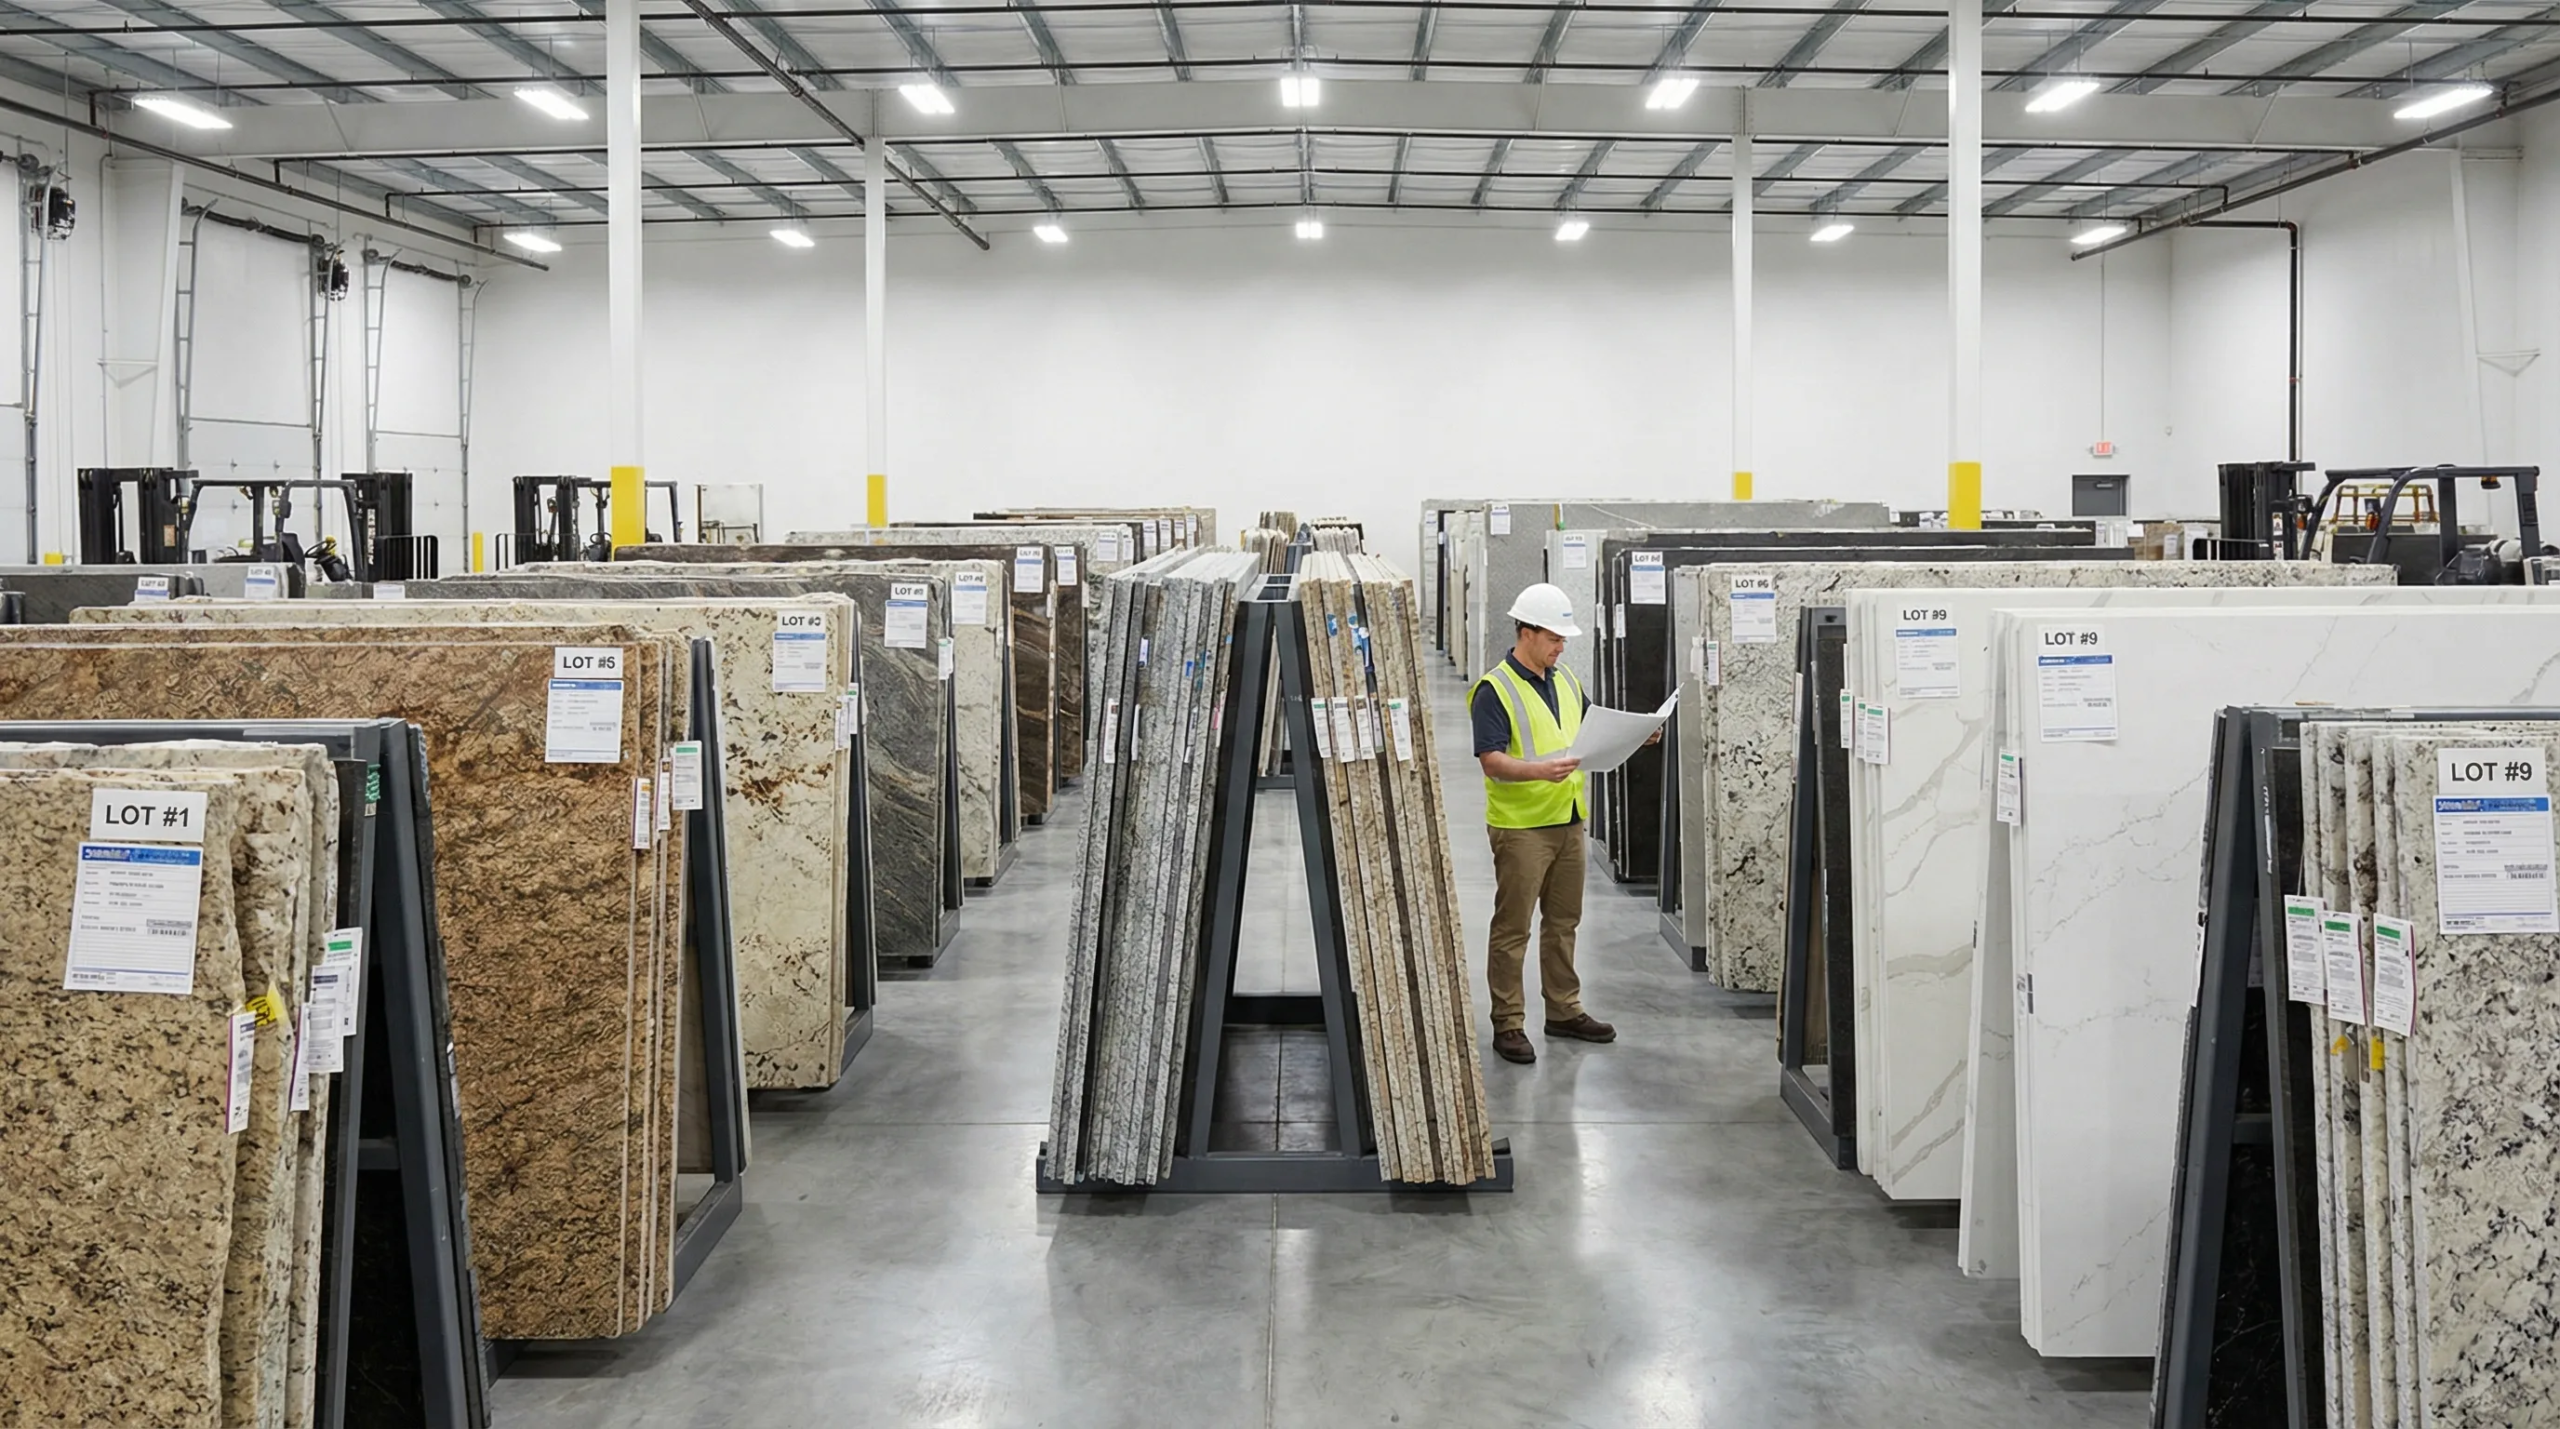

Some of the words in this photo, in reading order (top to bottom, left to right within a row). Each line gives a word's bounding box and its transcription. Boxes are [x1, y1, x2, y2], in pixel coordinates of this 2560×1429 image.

[1735, 579, 1754, 589] LOT
[895, 587, 911, 596] LOT
[782, 616, 805, 626] LOT
[1903, 609, 1928, 621] LOT
[2045, 632, 2075, 646] LOT
[2080, 631, 2098, 646] #9
[563, 656, 594, 669] LOT
[2451, 762, 2498, 782] LOT
[2504, 761, 2533, 782] #9
[106, 804, 156, 826] LOT
[162, 806, 189, 828] #1
